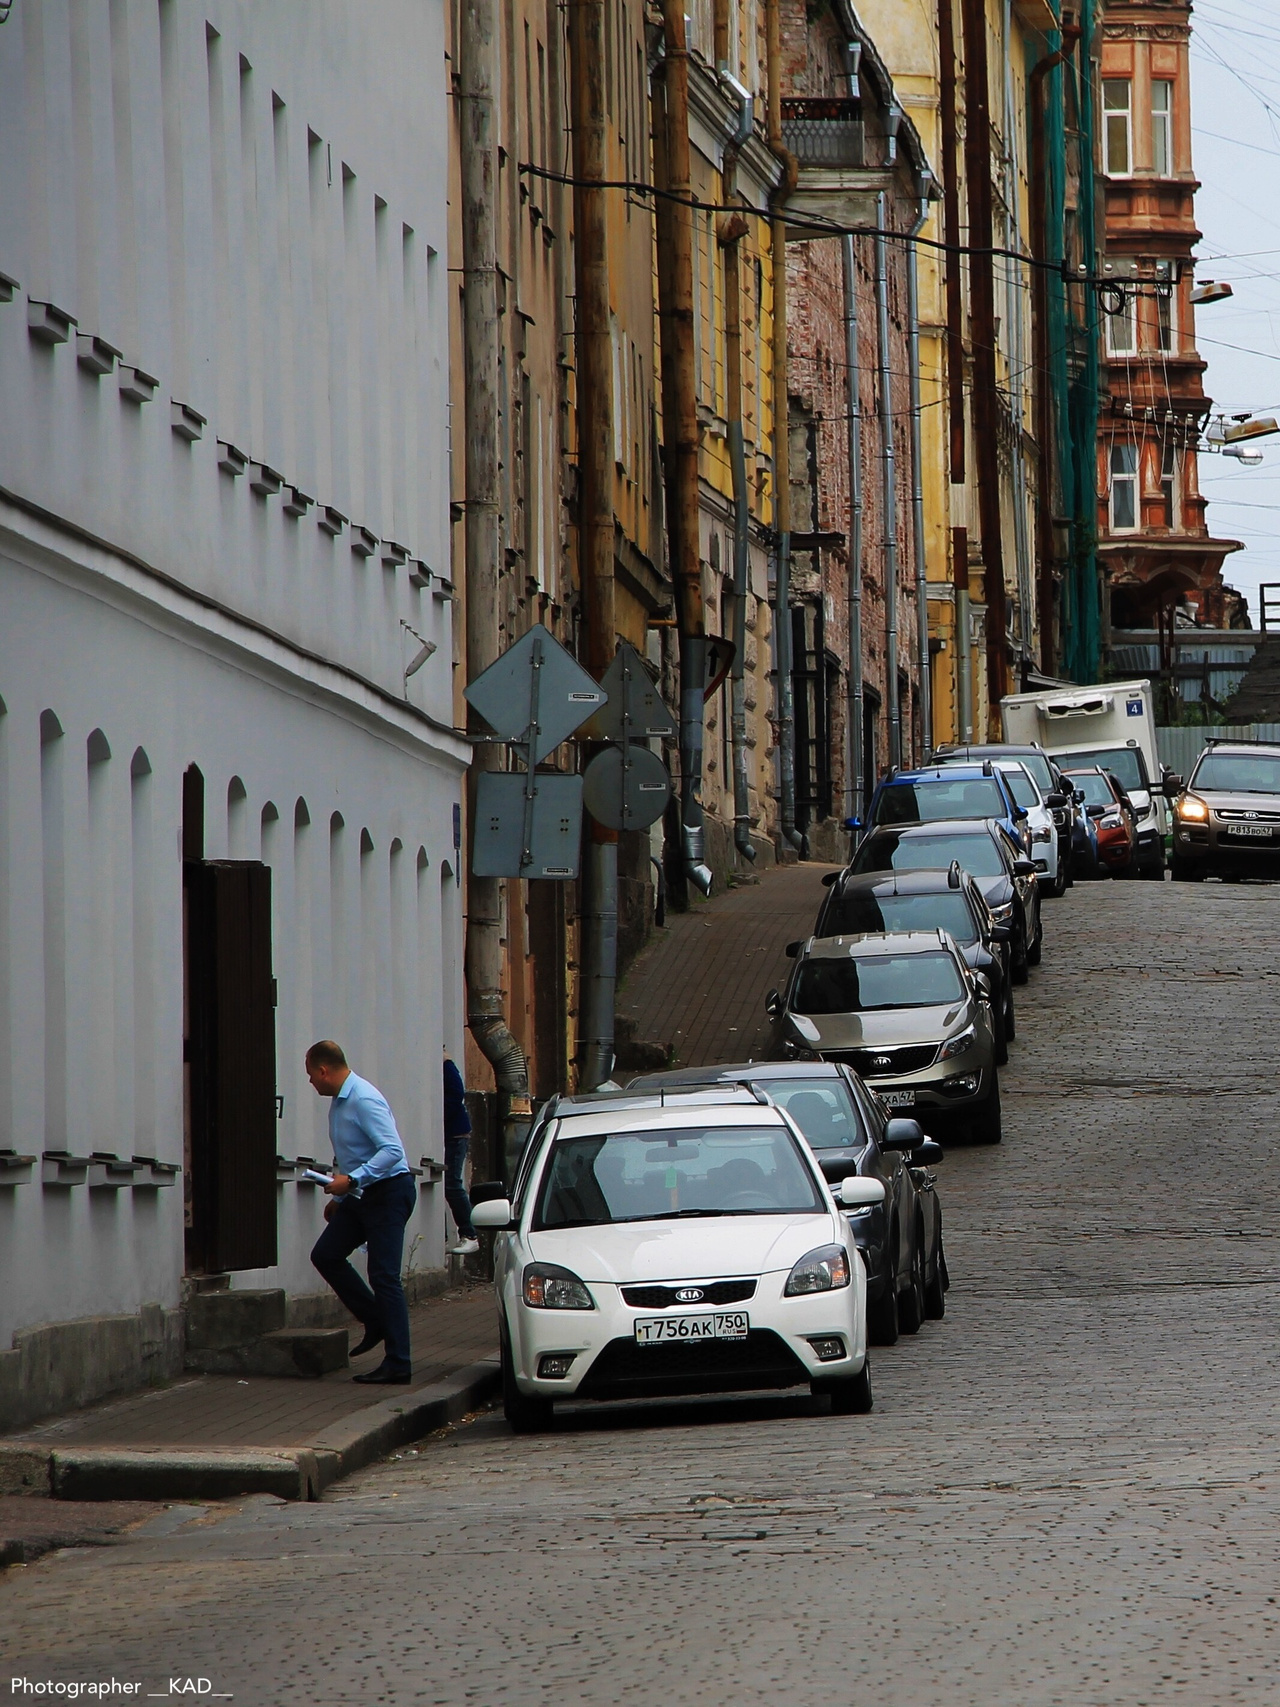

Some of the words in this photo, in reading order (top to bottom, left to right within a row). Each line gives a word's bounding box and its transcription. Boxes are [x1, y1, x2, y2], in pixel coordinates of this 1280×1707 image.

[1131, 704, 1138, 714] 4
[900, 1091, 911, 1100] 47
[680, 1290, 700, 1299] KIA
[642, 1319, 713, 1340] Т756АК
[716, 1314, 743, 1330] 750
